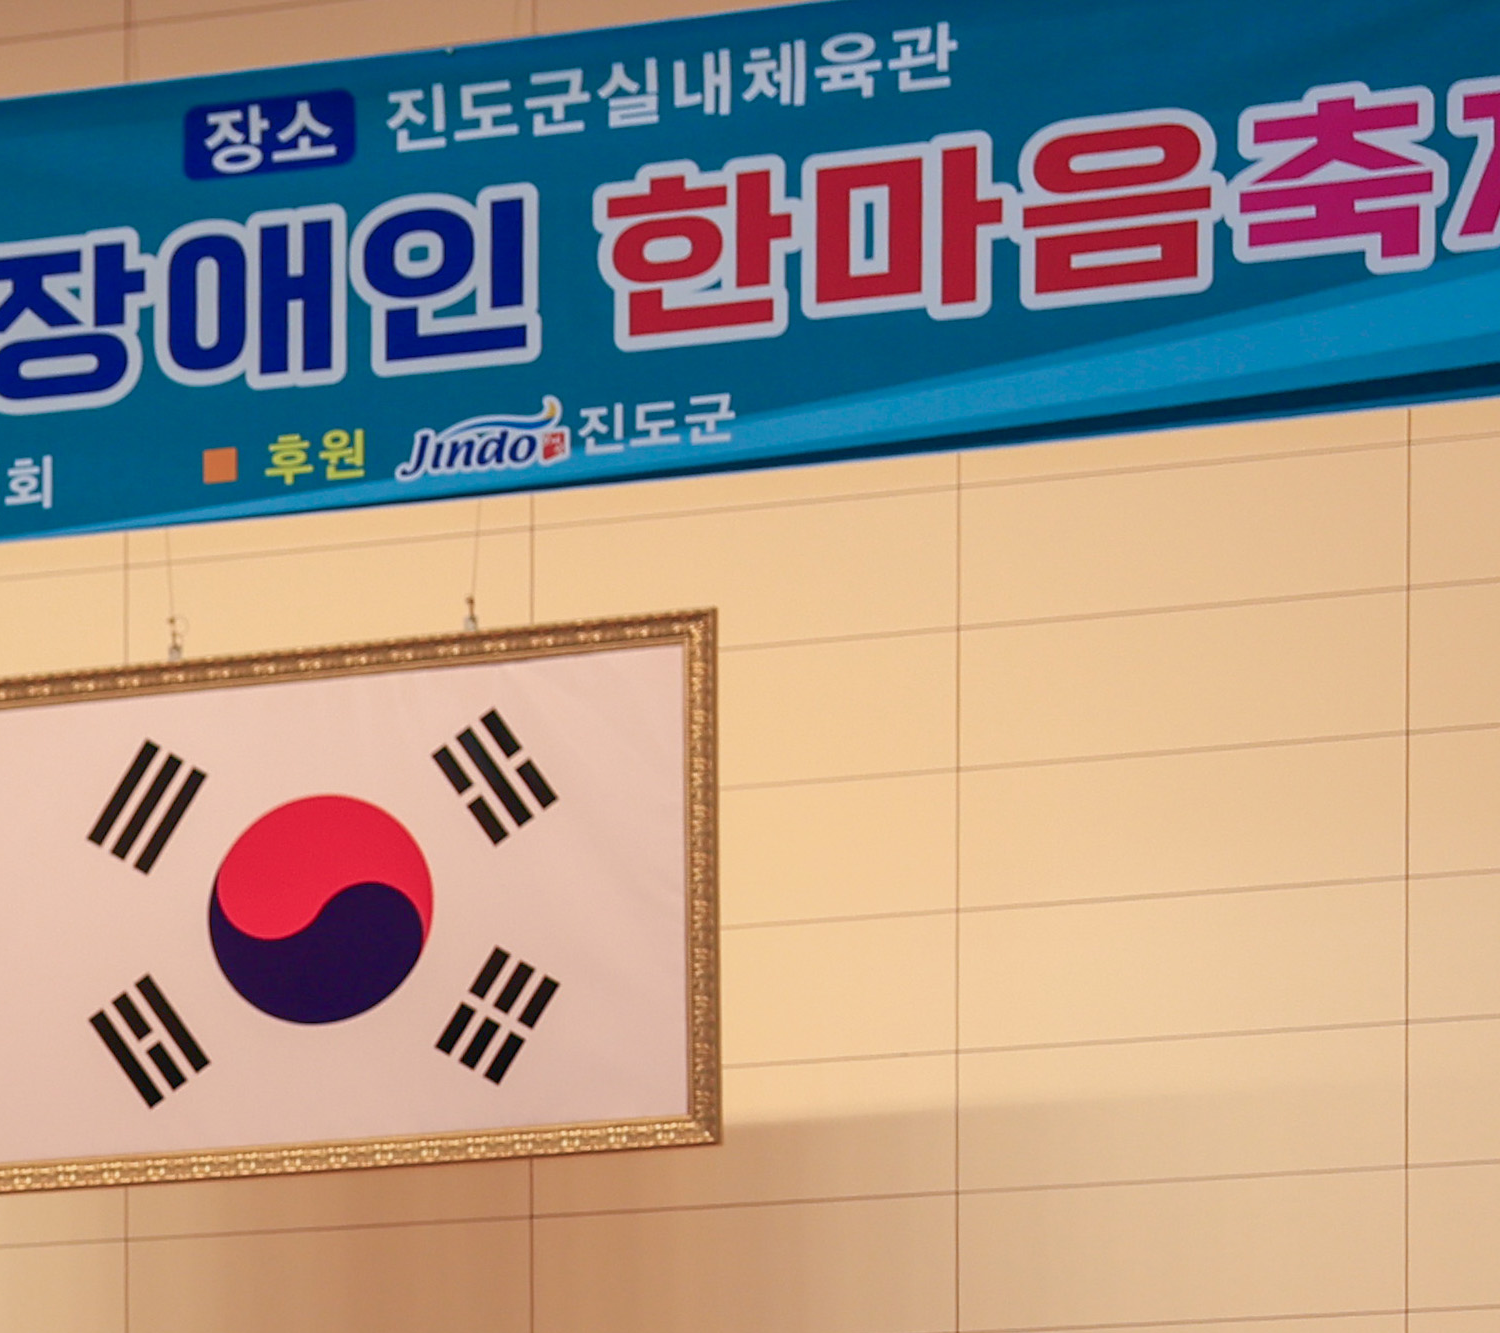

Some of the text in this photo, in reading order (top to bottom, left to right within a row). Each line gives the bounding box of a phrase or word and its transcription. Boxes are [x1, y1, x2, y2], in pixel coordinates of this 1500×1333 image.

[204, 21, 958, 174] 장소 진도군실내체육관
[264, 428, 367, 486] 후원
[397, 426, 538, 480] Jindo
[576, 391, 737, 455] 진도군
